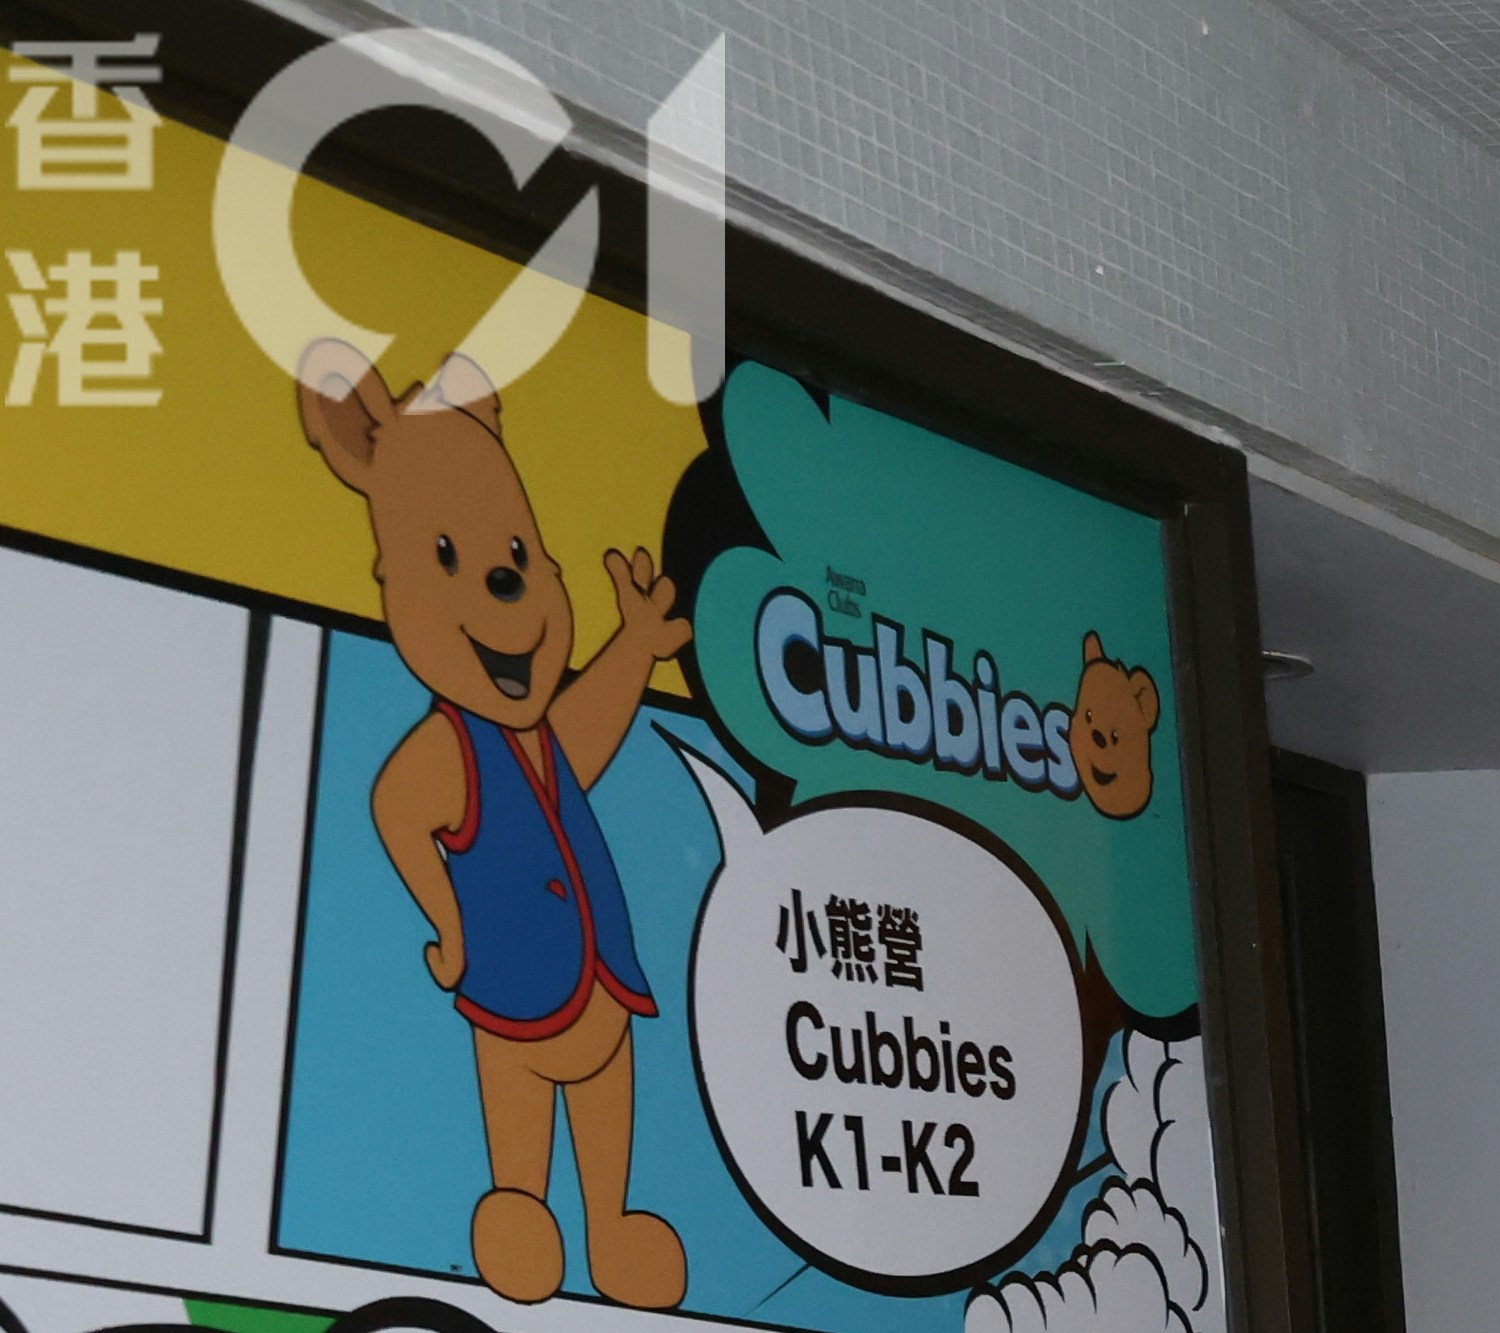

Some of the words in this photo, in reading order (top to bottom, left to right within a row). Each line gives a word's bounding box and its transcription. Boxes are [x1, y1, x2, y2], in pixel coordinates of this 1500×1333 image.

[756, 588, 1083, 798] Cubbies
[776, 888, 924, 992] 小熊營
[785, 1000, 1016, 1101] Cubbies
[794, 1110, 980, 1198] K1-K2
